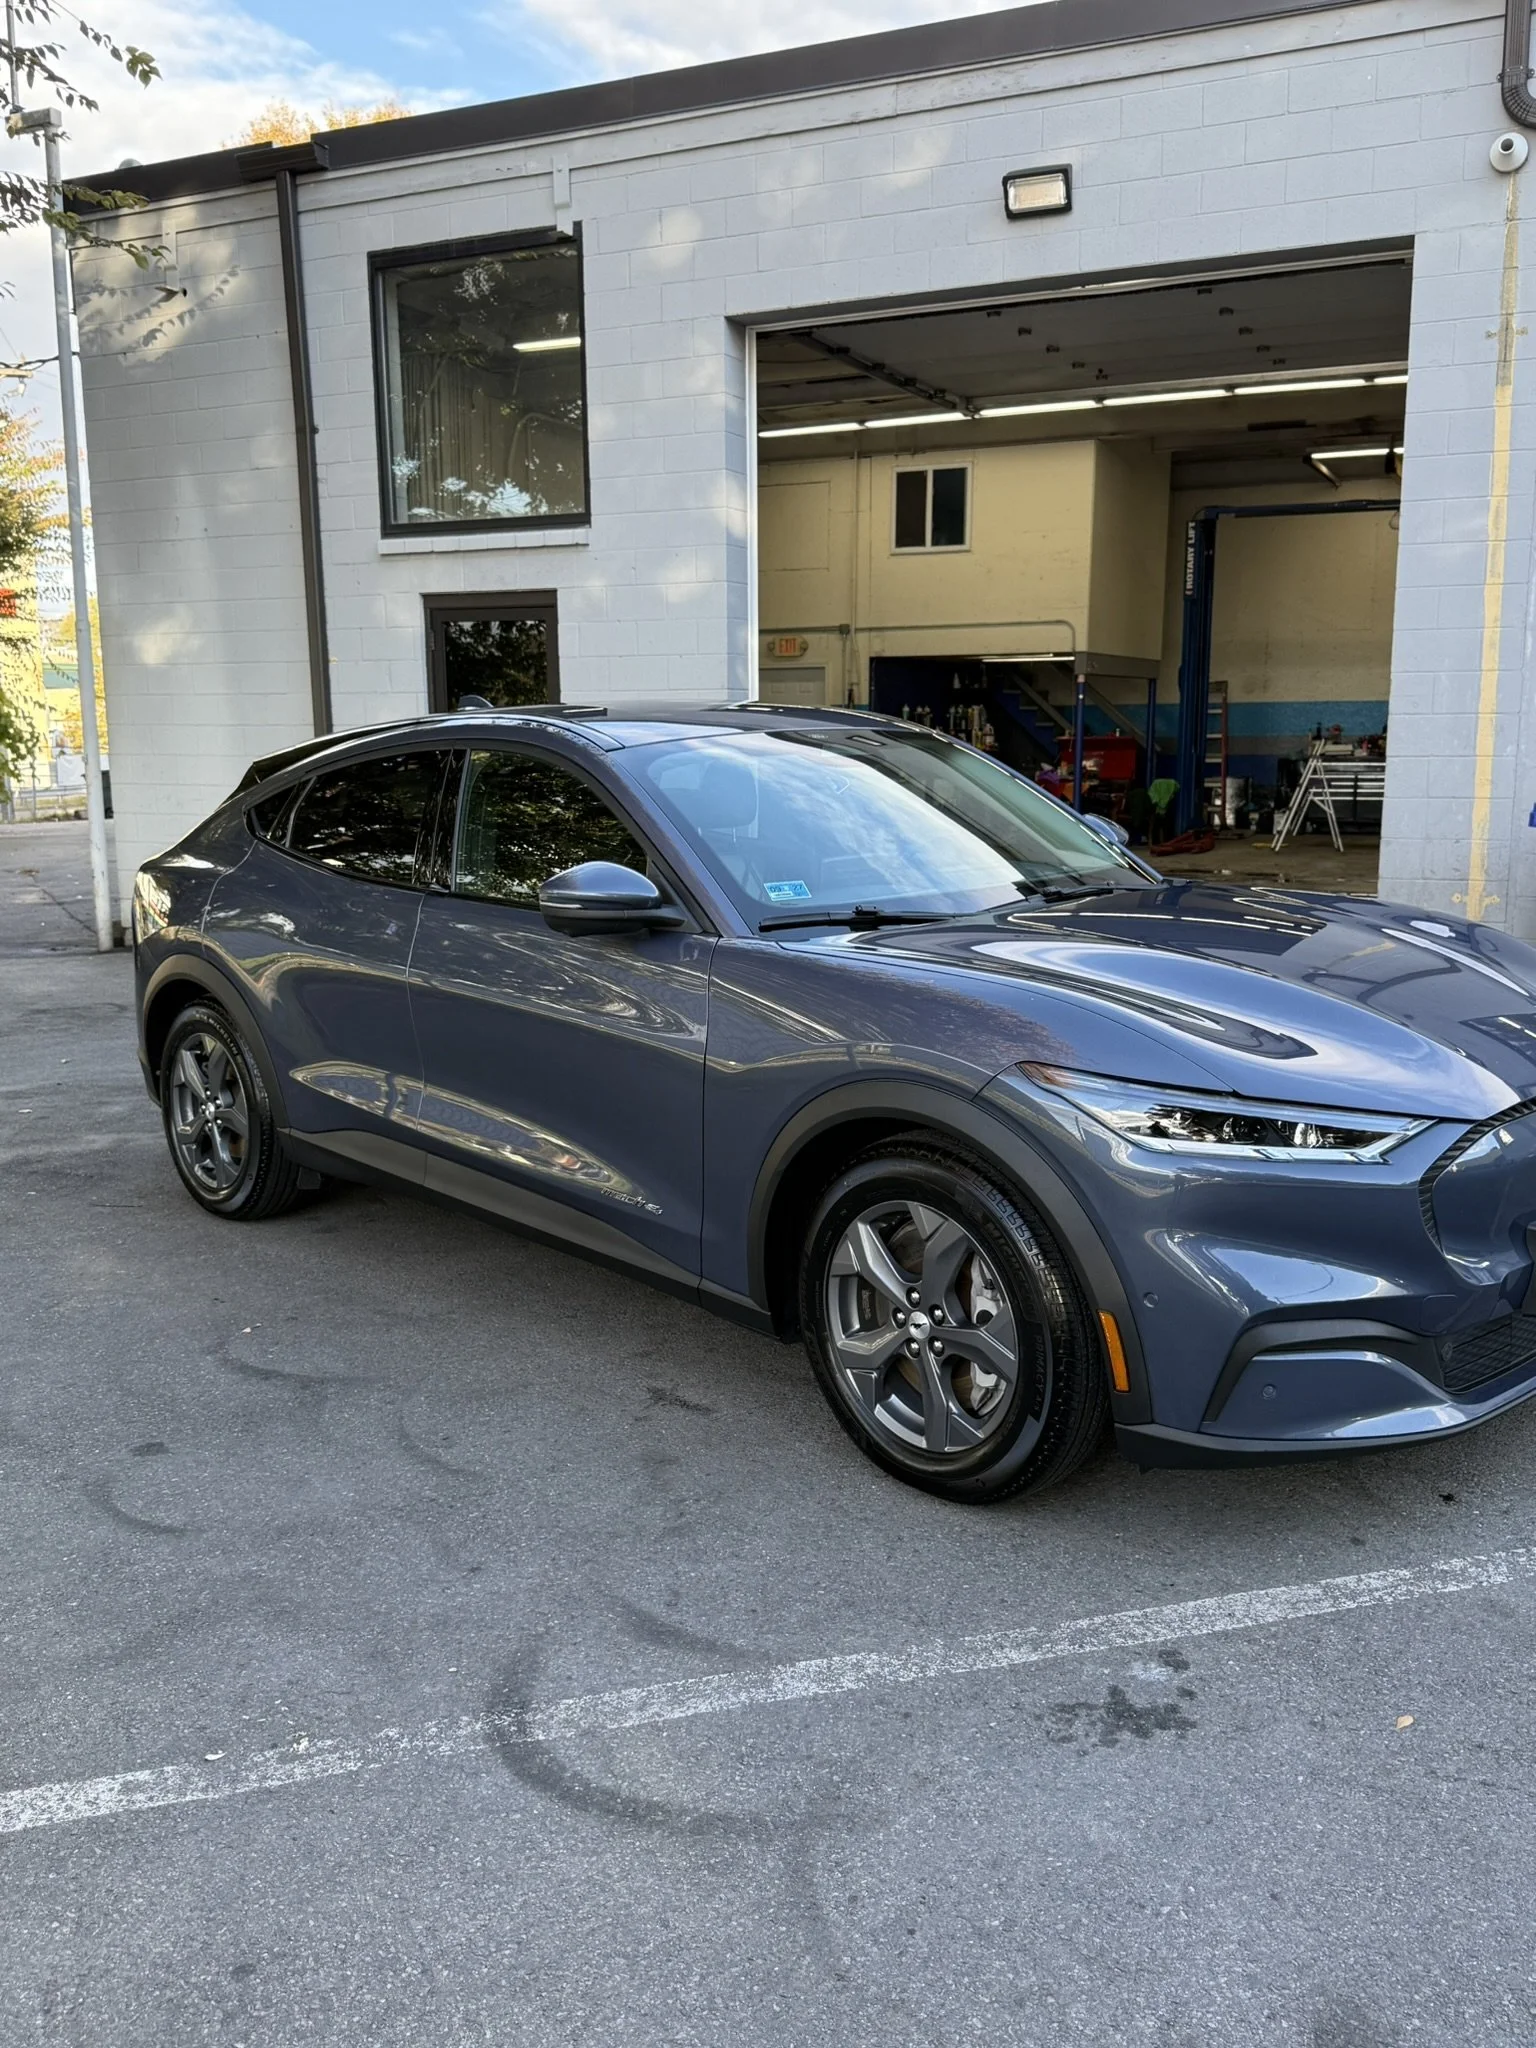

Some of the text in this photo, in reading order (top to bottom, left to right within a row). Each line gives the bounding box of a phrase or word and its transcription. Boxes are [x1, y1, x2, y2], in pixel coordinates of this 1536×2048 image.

[1185, 521, 1196, 589] ROTARY LIFT
[777, 638, 797, 654] EXIT
[208, 1018, 239, 1056] MICHELIN
[1034, 1335, 1046, 1392] PRIMACY
